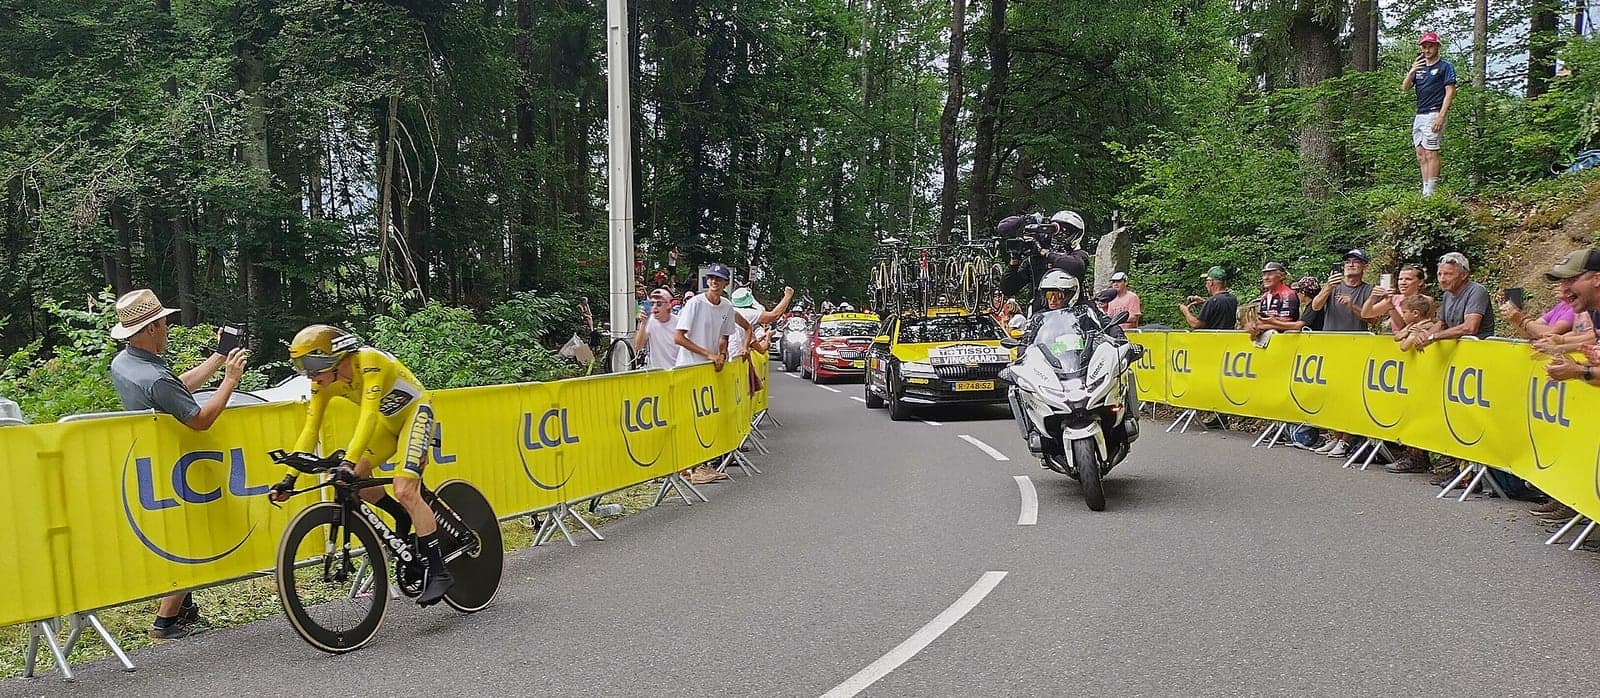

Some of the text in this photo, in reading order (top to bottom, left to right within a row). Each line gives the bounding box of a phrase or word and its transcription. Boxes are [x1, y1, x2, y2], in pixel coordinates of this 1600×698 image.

[943, 355, 998, 364] VINGEGAARD
[956, 347, 998, 355] TISSOT
[1172, 349, 1191, 373] LCL
[1223, 352, 1256, 378] LCL
[1294, 354, 1327, 384] LCL
[1367, 359, 1408, 394] LCL
[693, 385, 719, 417] LCL
[1447, 366, 1490, 408] LCL
[1531, 376, 1570, 427] LCL
[523, 408, 579, 450] LCL
[624, 396, 667, 432] LCL
[407, 411, 428, 467] JUMBO
[136, 447, 270, 511] LCL
